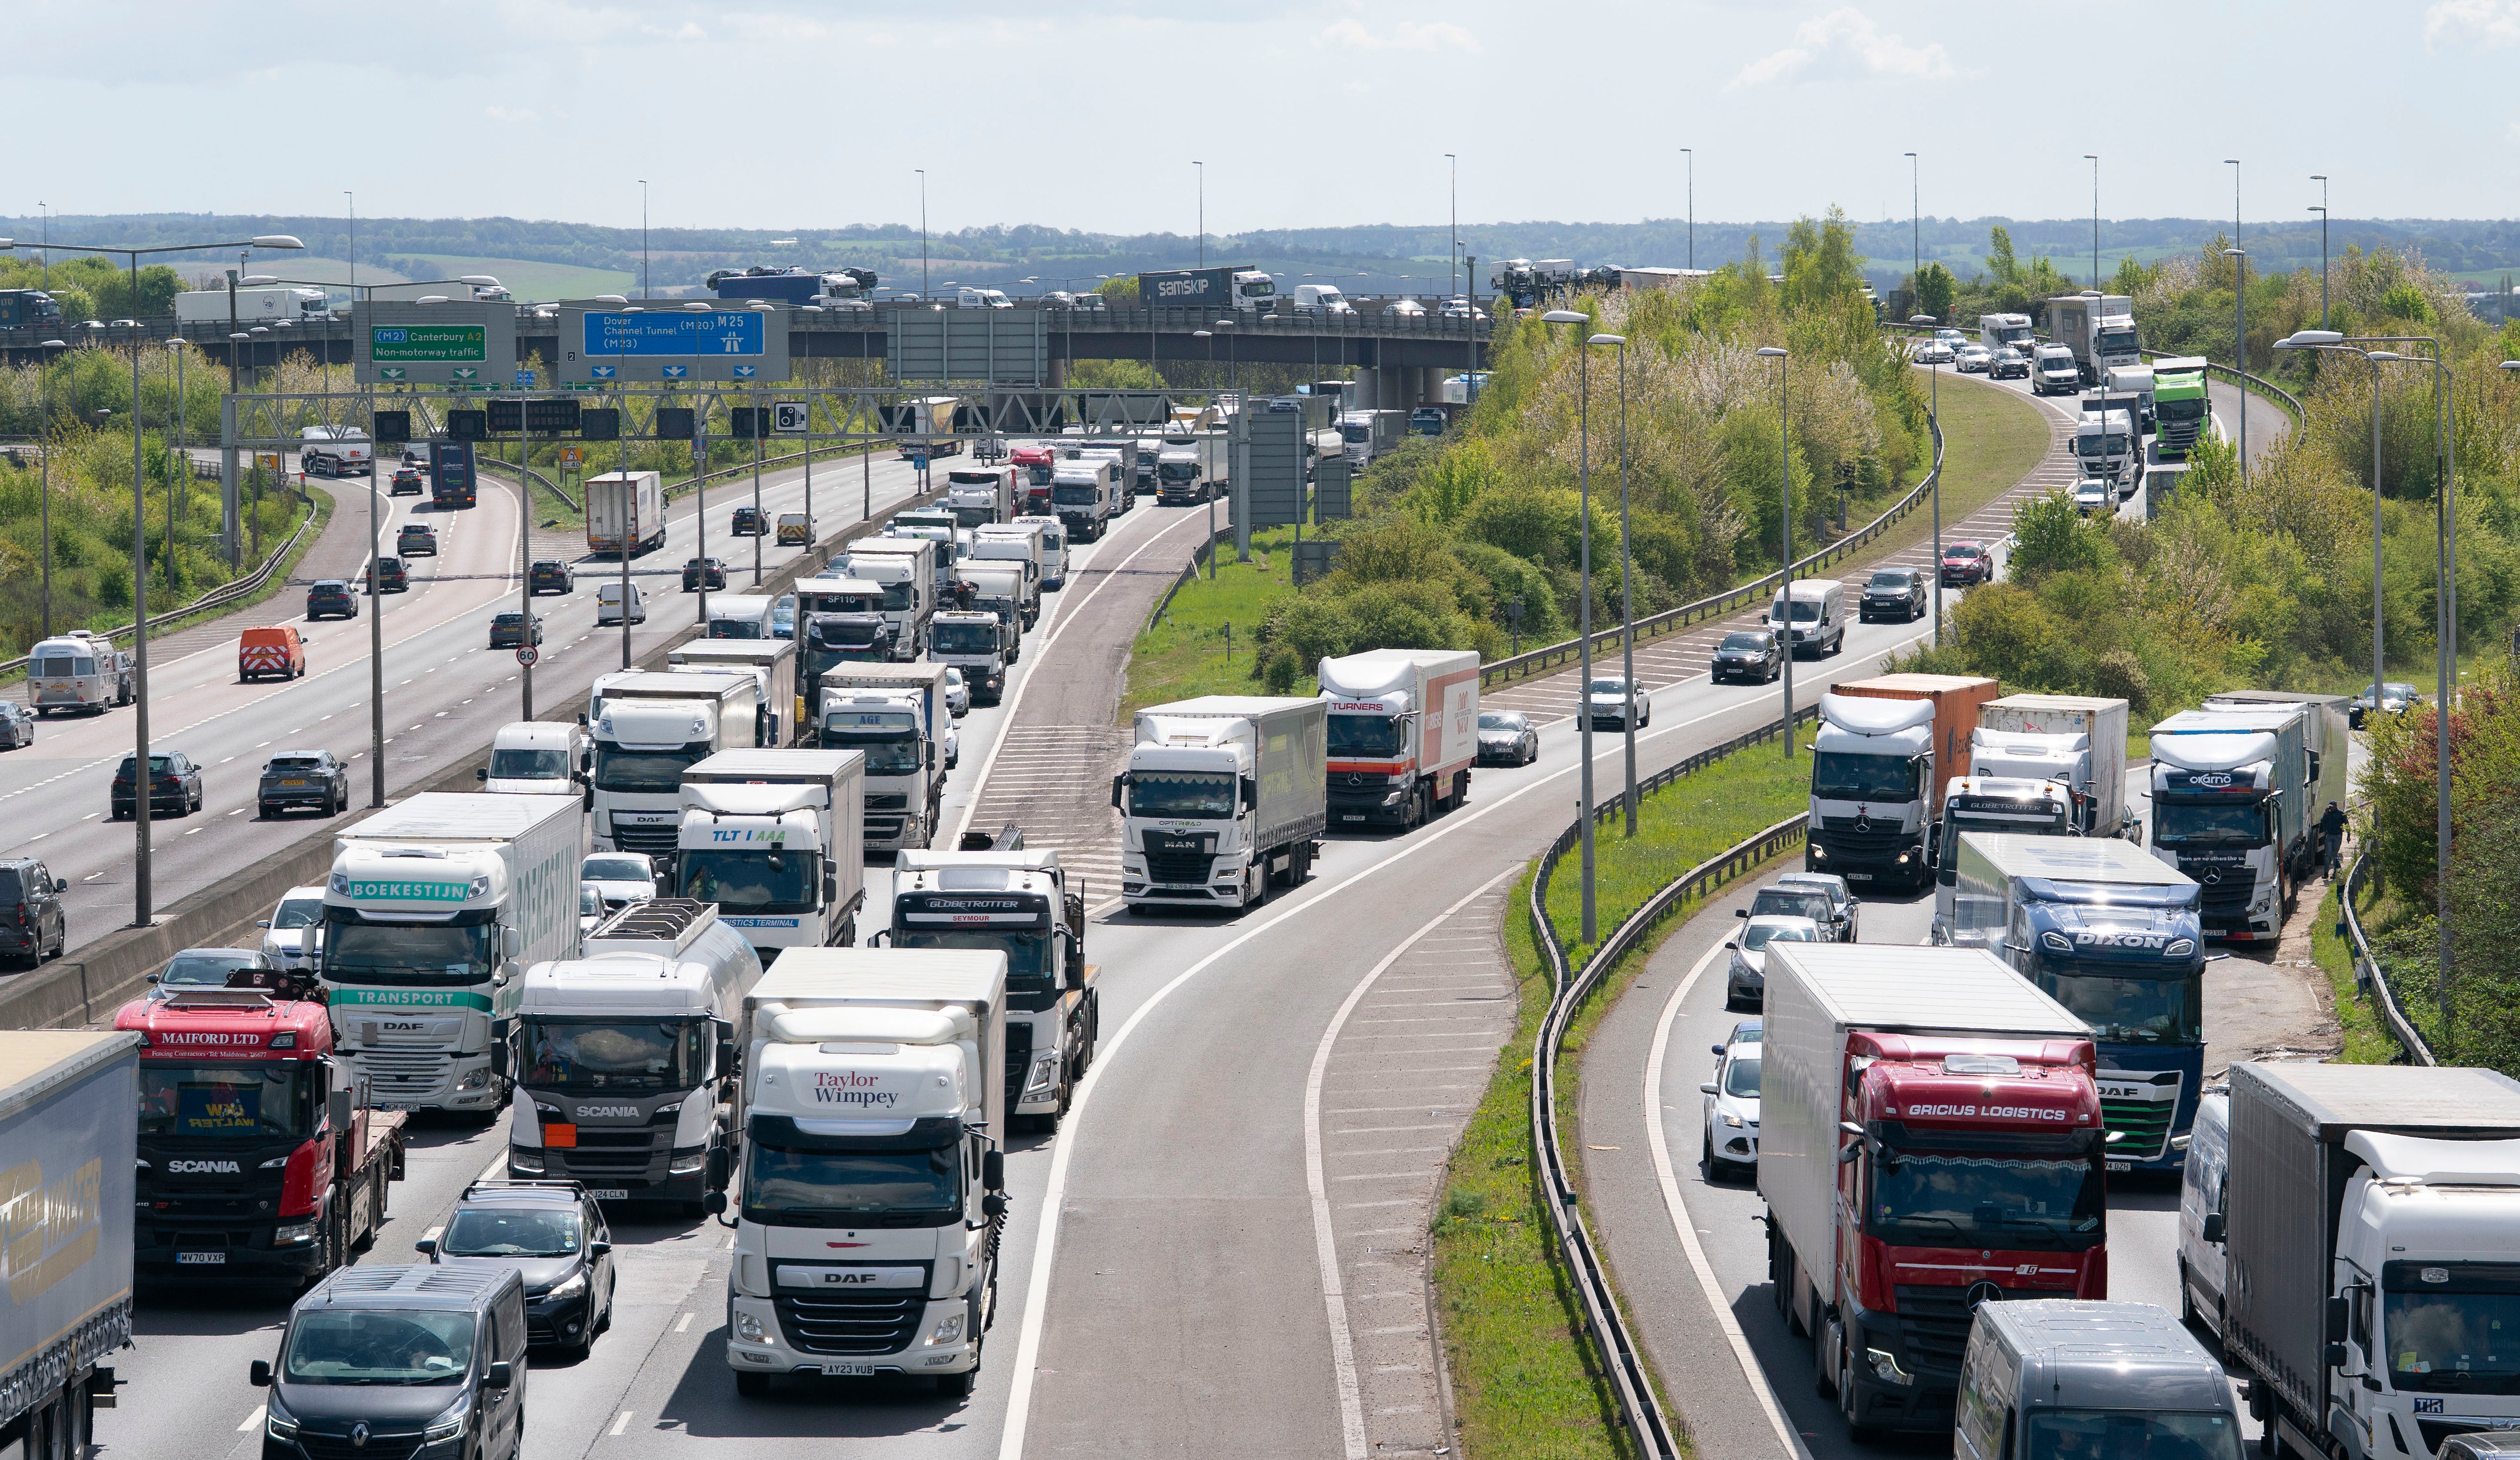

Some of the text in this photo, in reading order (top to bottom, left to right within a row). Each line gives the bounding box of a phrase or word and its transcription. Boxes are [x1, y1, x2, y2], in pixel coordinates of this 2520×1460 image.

[604, 316, 631, 325] Dover
[604, 326, 677, 335] Channel Tunnel
[410, 332, 464, 342] Canterbury
[468, 332, 481, 341] A2
[376, 347, 479, 357] Non-motorway traffic
[519, 652, 534, 660] 60
[860, 716, 880, 724] AGE
[713, 831, 741, 842] TLT
[755, 831, 786, 841] AAA
[353, 884, 463, 899] BOEKESTIJN
[929, 900, 1018, 908] GLOBETROTTER
[2075, 933, 2165, 949] DIXON
[357, 991, 454, 1006] TRANSPORT
[162, 1033, 259, 1044] MAIFORD LTD
[815, 1071, 879, 1091] Taylor
[814, 1088, 899, 1108] Wimpey
[576, 1106, 640, 1117] SCANIA
[1909, 1105, 2066, 1120] GRICIUS LOGISTICS
[168, 1160, 241, 1173] SCANIA
[207, 1254, 225, 1262] VXP
[825, 1274, 876, 1283] DAF
[828, 1365, 873, 1374] AY23 VUB
[2417, 1399, 2441, 1412] TIR
